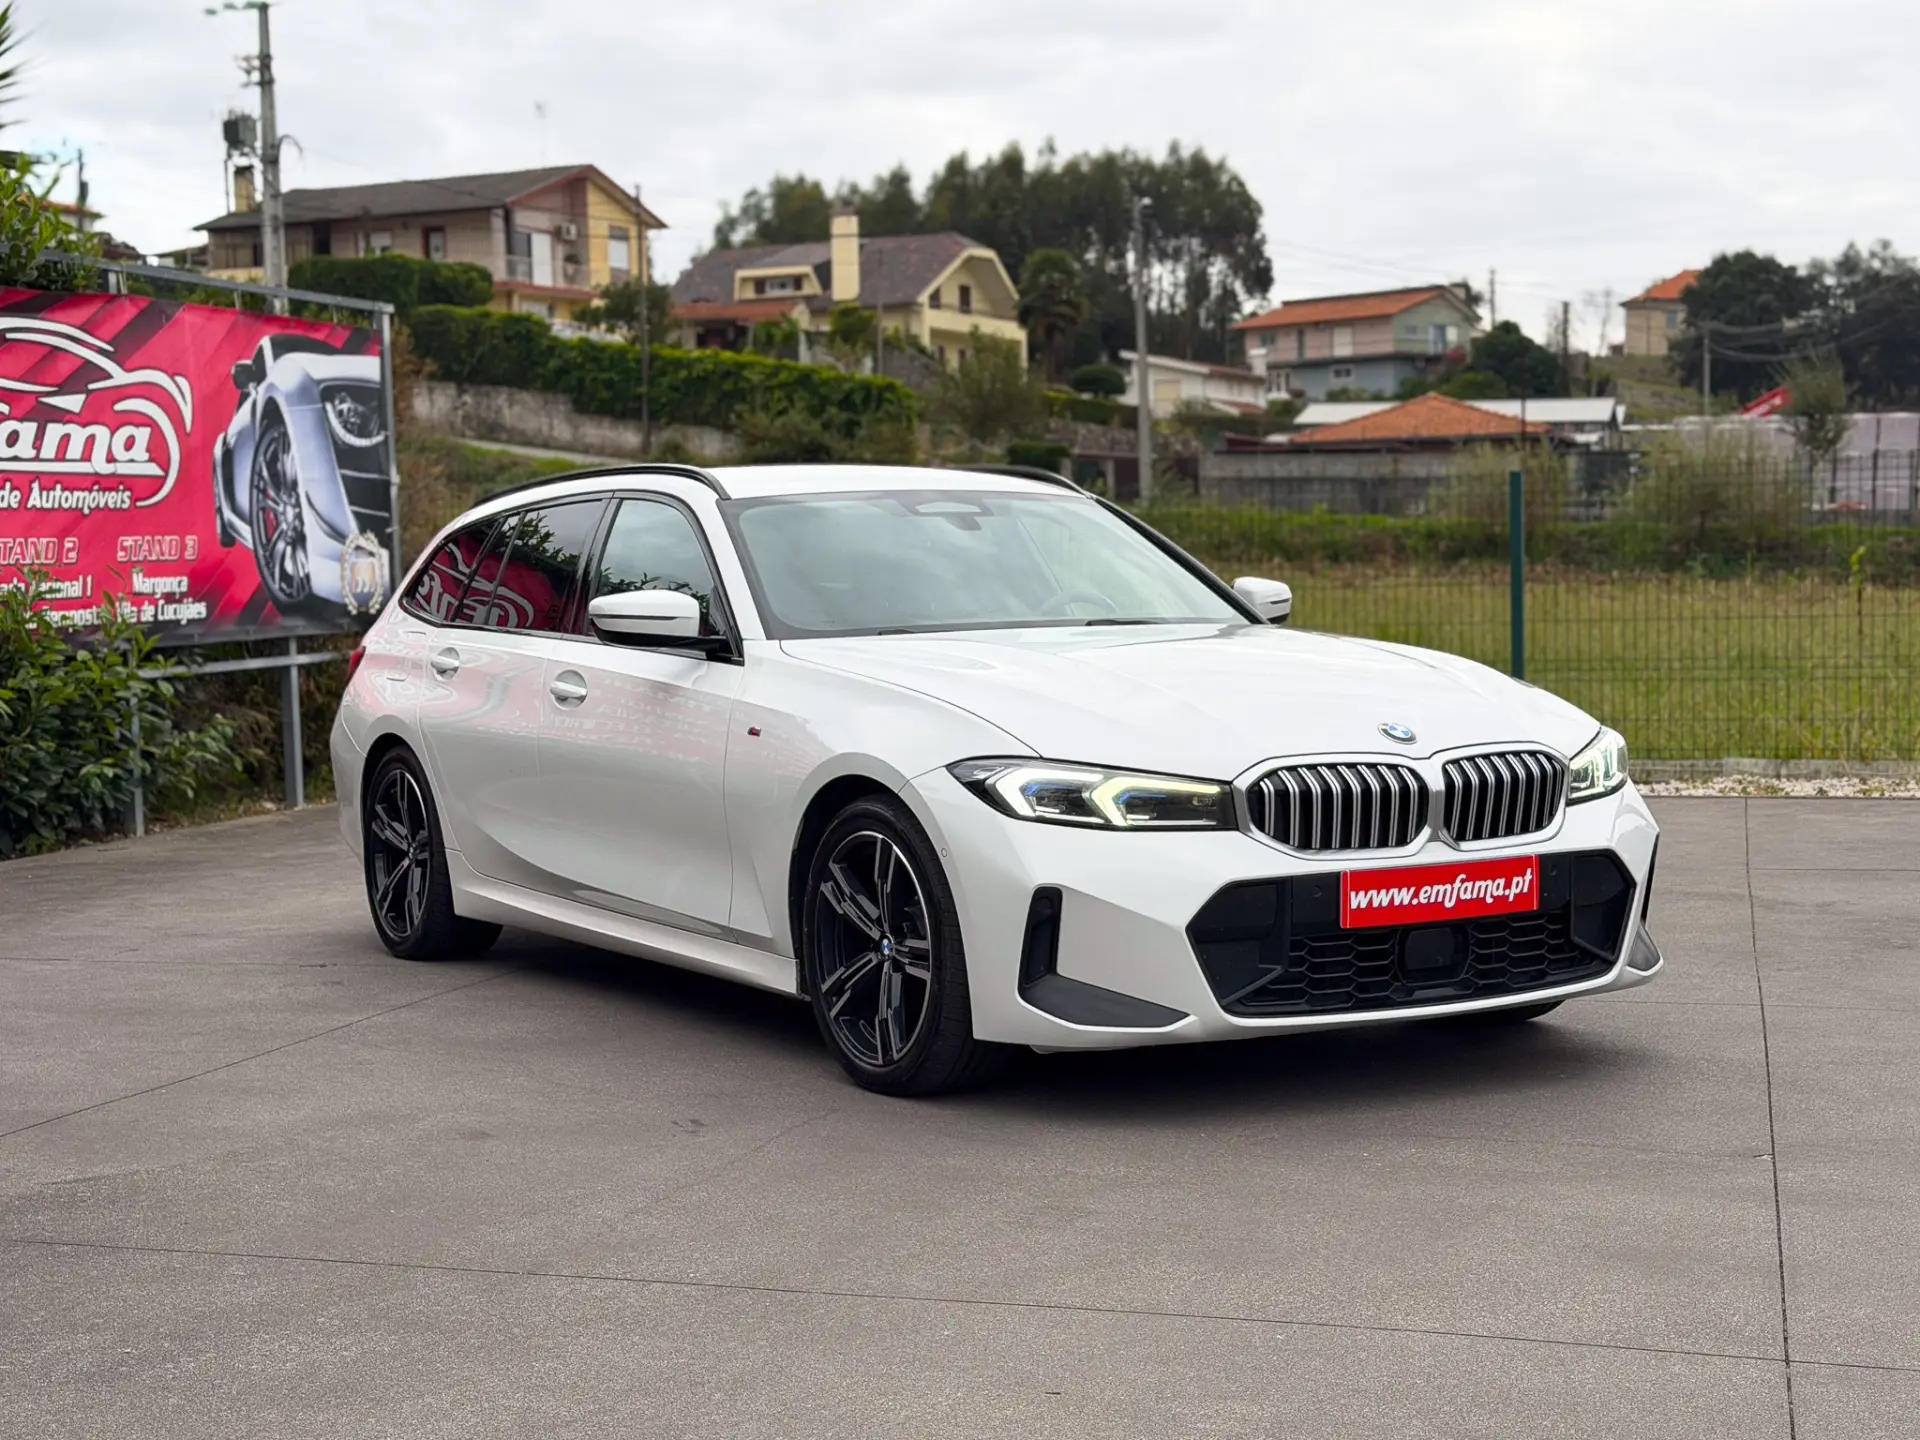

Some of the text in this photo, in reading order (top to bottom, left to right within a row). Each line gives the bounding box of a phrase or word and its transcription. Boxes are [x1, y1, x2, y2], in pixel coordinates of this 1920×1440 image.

[27, 479, 131, 515] Automóveis
[62, 537, 79, 563] 2
[117, 535, 198, 562] STAND 3
[133, 571, 188, 599] Margonça
[141, 600, 155, 622] de
[158, 598, 207, 625] Cucujães
[1350, 868, 1532, 908] www.emfama.pt
